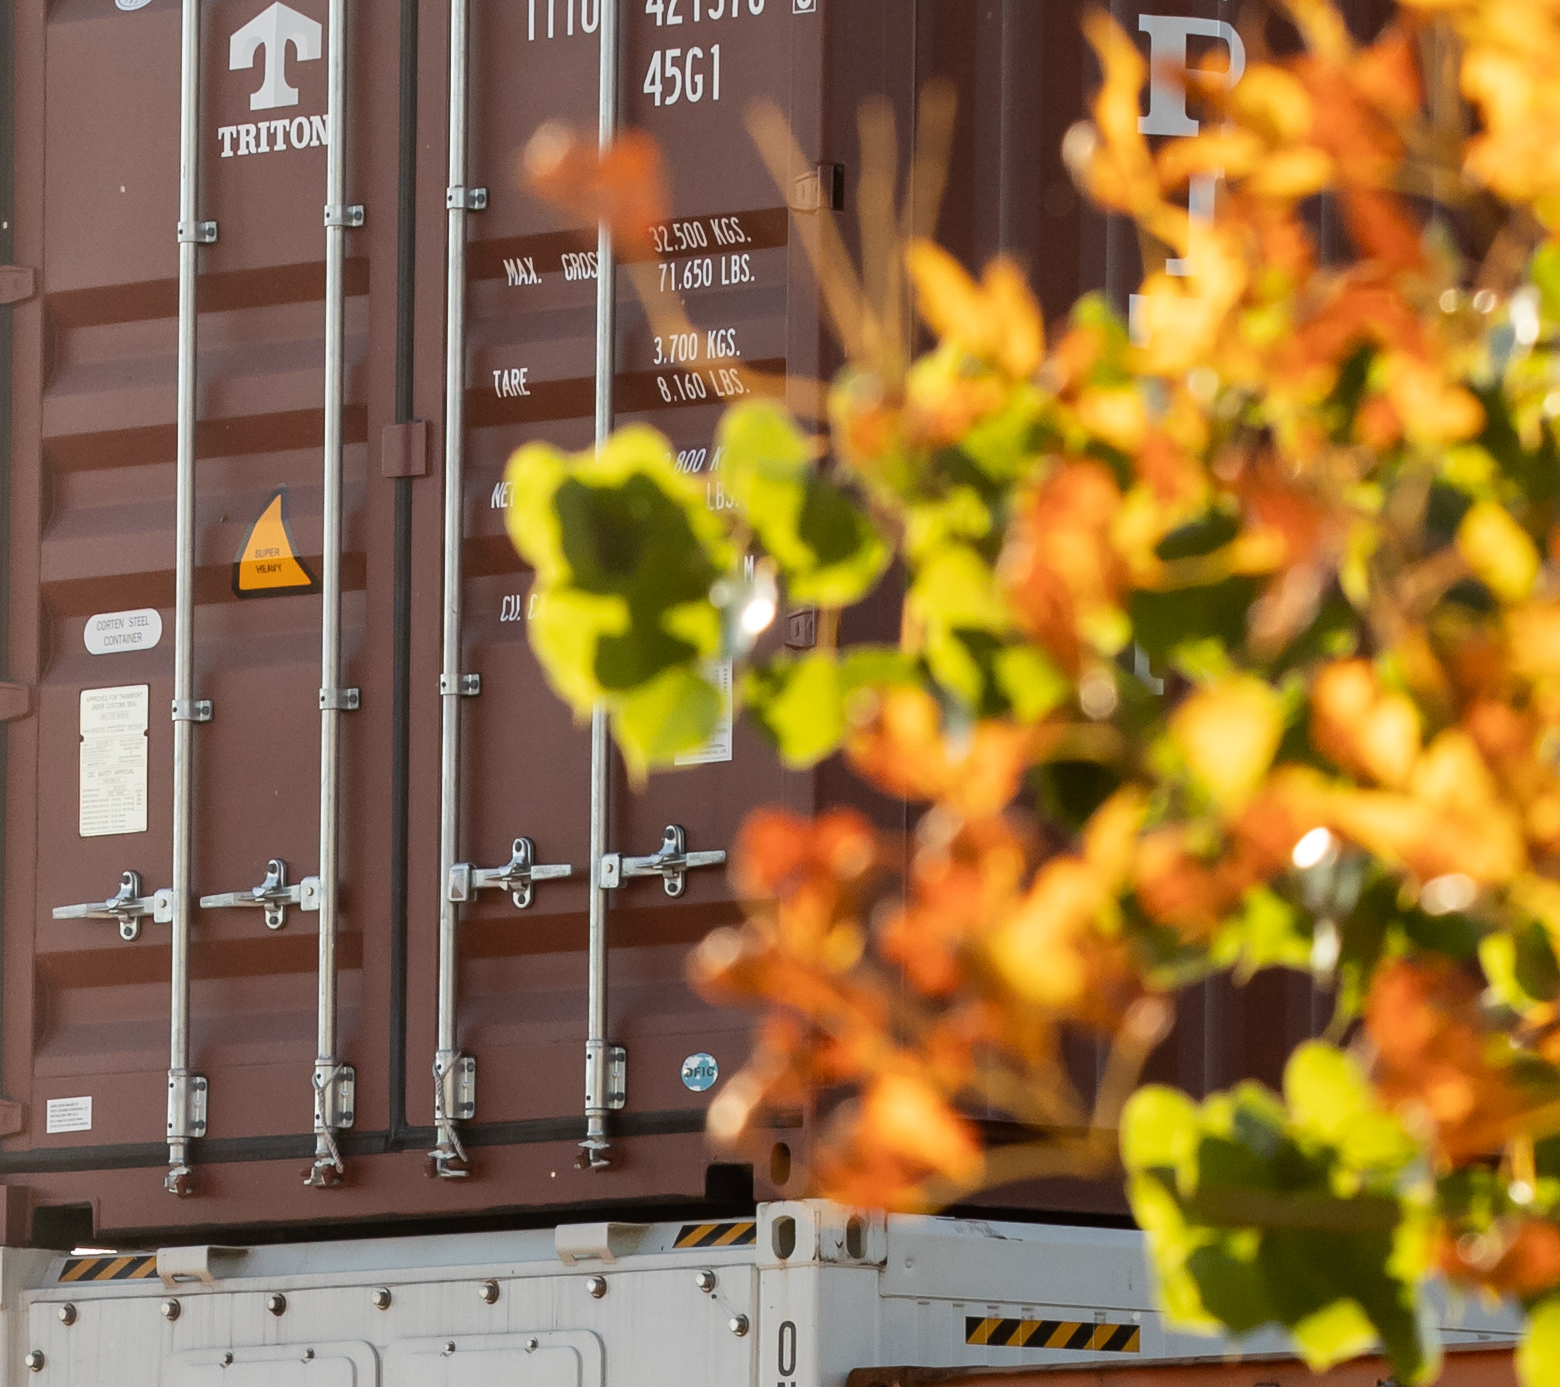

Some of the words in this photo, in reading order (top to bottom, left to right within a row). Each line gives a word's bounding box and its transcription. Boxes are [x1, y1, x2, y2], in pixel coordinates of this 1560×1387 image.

[643, 43, 721, 107] 45G1
[216, 114, 329, 158] TRITON
[709, 216, 752, 247] KGS.
[503, 256, 543, 287] MAX.
[560, 250, 600, 282] GROS
[720, 254, 756, 286] LBS.
[706, 327, 741, 360] KGS.
[493, 366, 531, 399] TARE
[708, 367, 751, 398] LBS.
[96, 617, 125, 633] CORTEN
[128, 614, 150, 629] STEEL
[103, 631, 143, 648] CONTAINER
